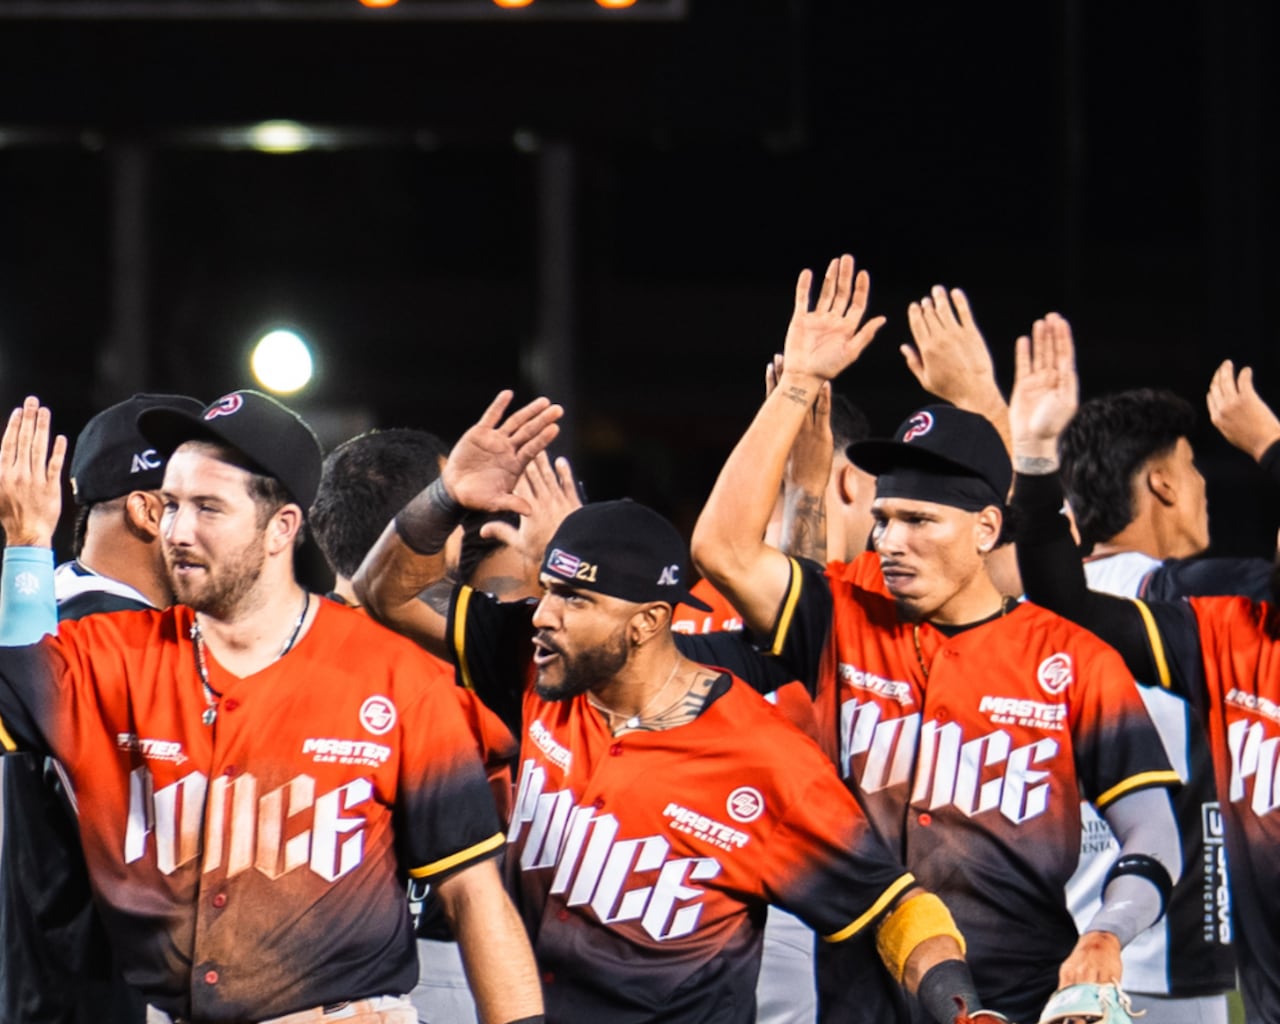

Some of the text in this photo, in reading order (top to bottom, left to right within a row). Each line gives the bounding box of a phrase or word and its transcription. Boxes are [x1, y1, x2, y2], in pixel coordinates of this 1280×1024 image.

[576, 562, 598, 582] 21
[302, 738, 392, 763] MASTER
[662, 802, 750, 848] MASTER
